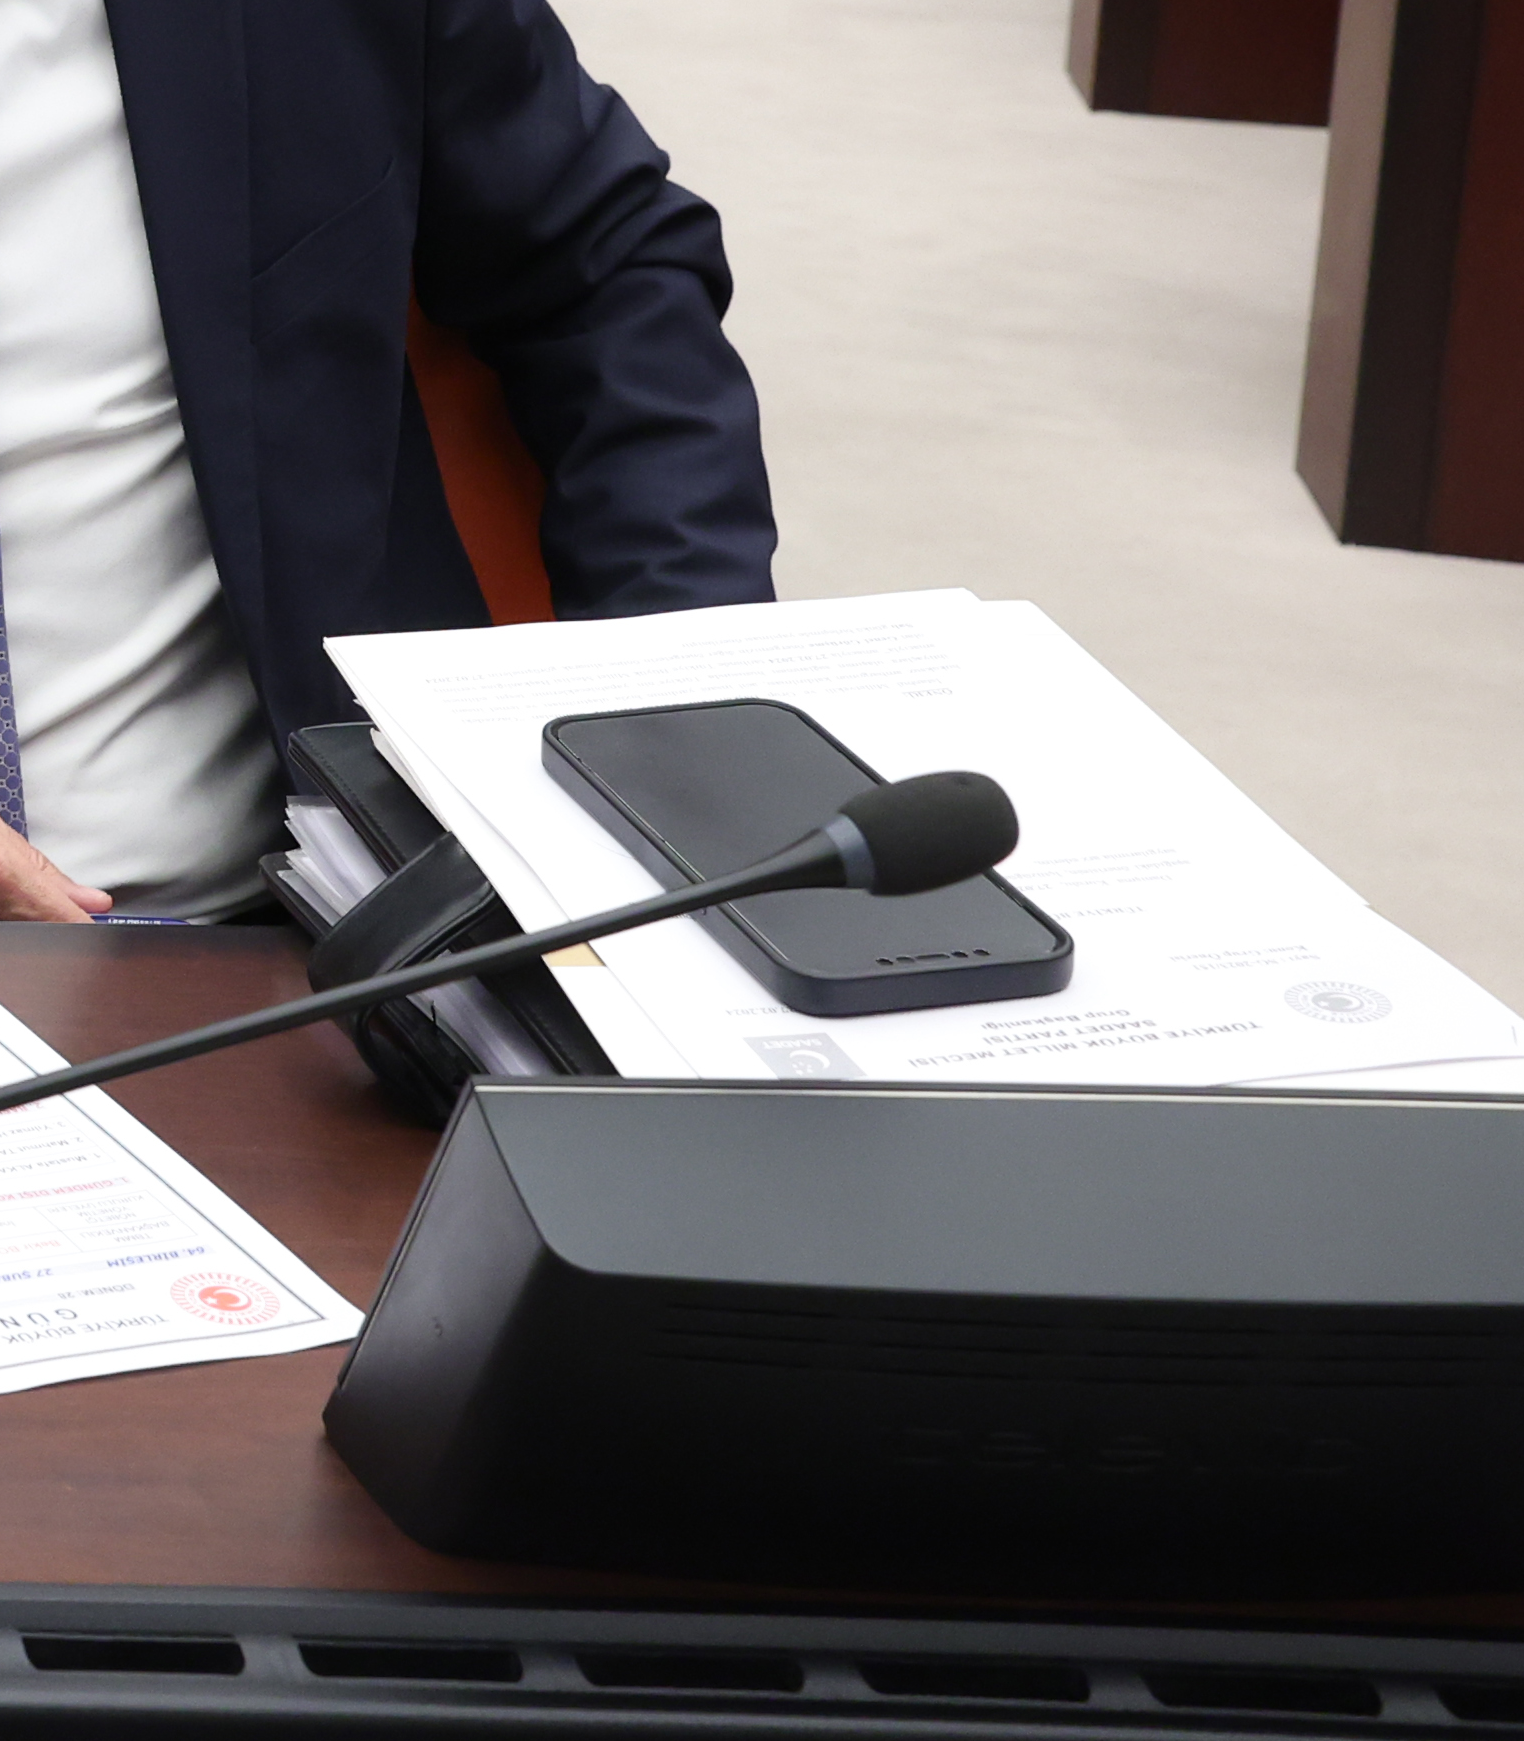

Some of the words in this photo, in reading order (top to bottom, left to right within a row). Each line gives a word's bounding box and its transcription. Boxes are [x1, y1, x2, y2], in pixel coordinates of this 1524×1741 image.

[981, 1028, 1066, 1045] PARTİSİ
[1163, 1021, 1263, 1040] TÜRKİYE
[762, 1038, 822, 1049] SAADET
[1079, 1032, 1160, 1049] BÜYÜK
[1001, 1041, 1077, 1058] MİLLET
[907, 1049, 995, 1068] MECLİSİ
[37, 1268, 53, 1278] 27
[77, 1313, 169, 1334] TÜRKİYE
[0, 1325, 77, 1346] BÜYÜK
